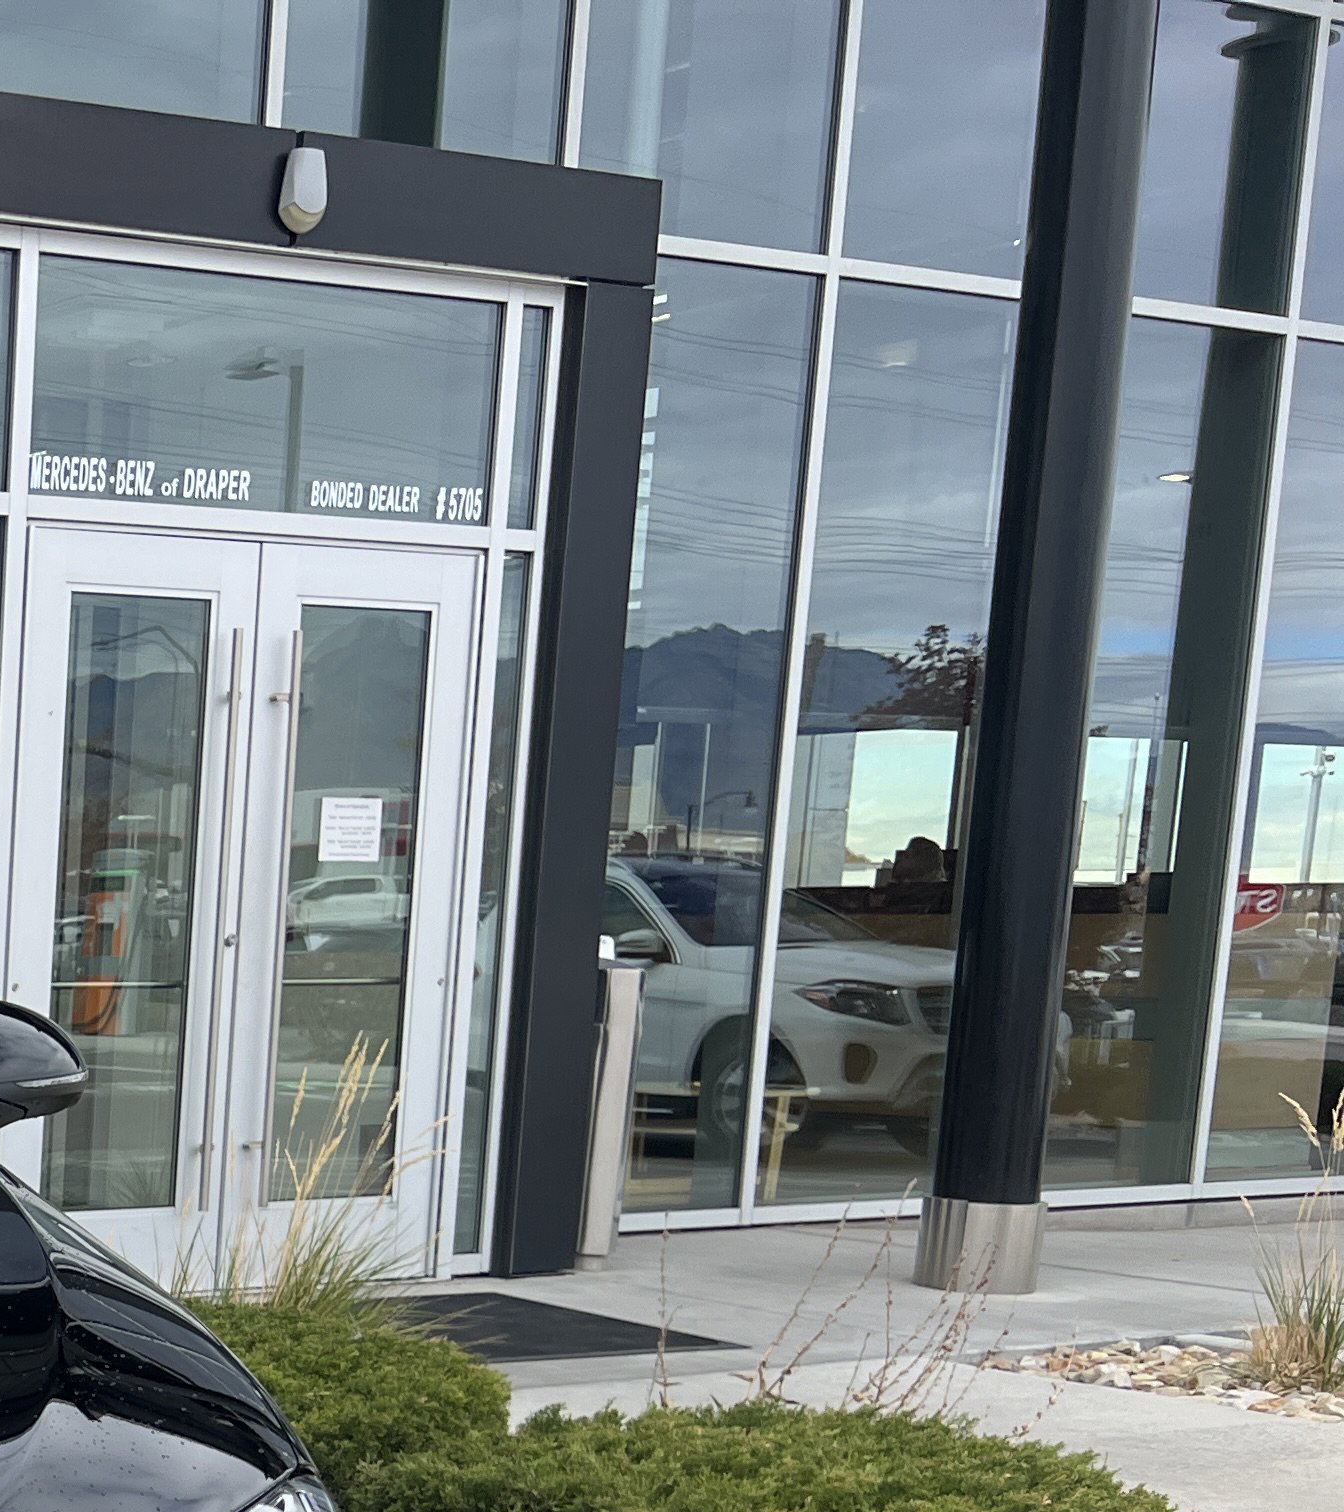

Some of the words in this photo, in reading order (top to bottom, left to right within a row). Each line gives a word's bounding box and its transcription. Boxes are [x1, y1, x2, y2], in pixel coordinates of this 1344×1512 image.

[161, 478, 179, 496] of
[183, 468, 251, 501] DRAPER
[311, 481, 362, 509] BONDED
[368, 485, 420, 513] DEALER
